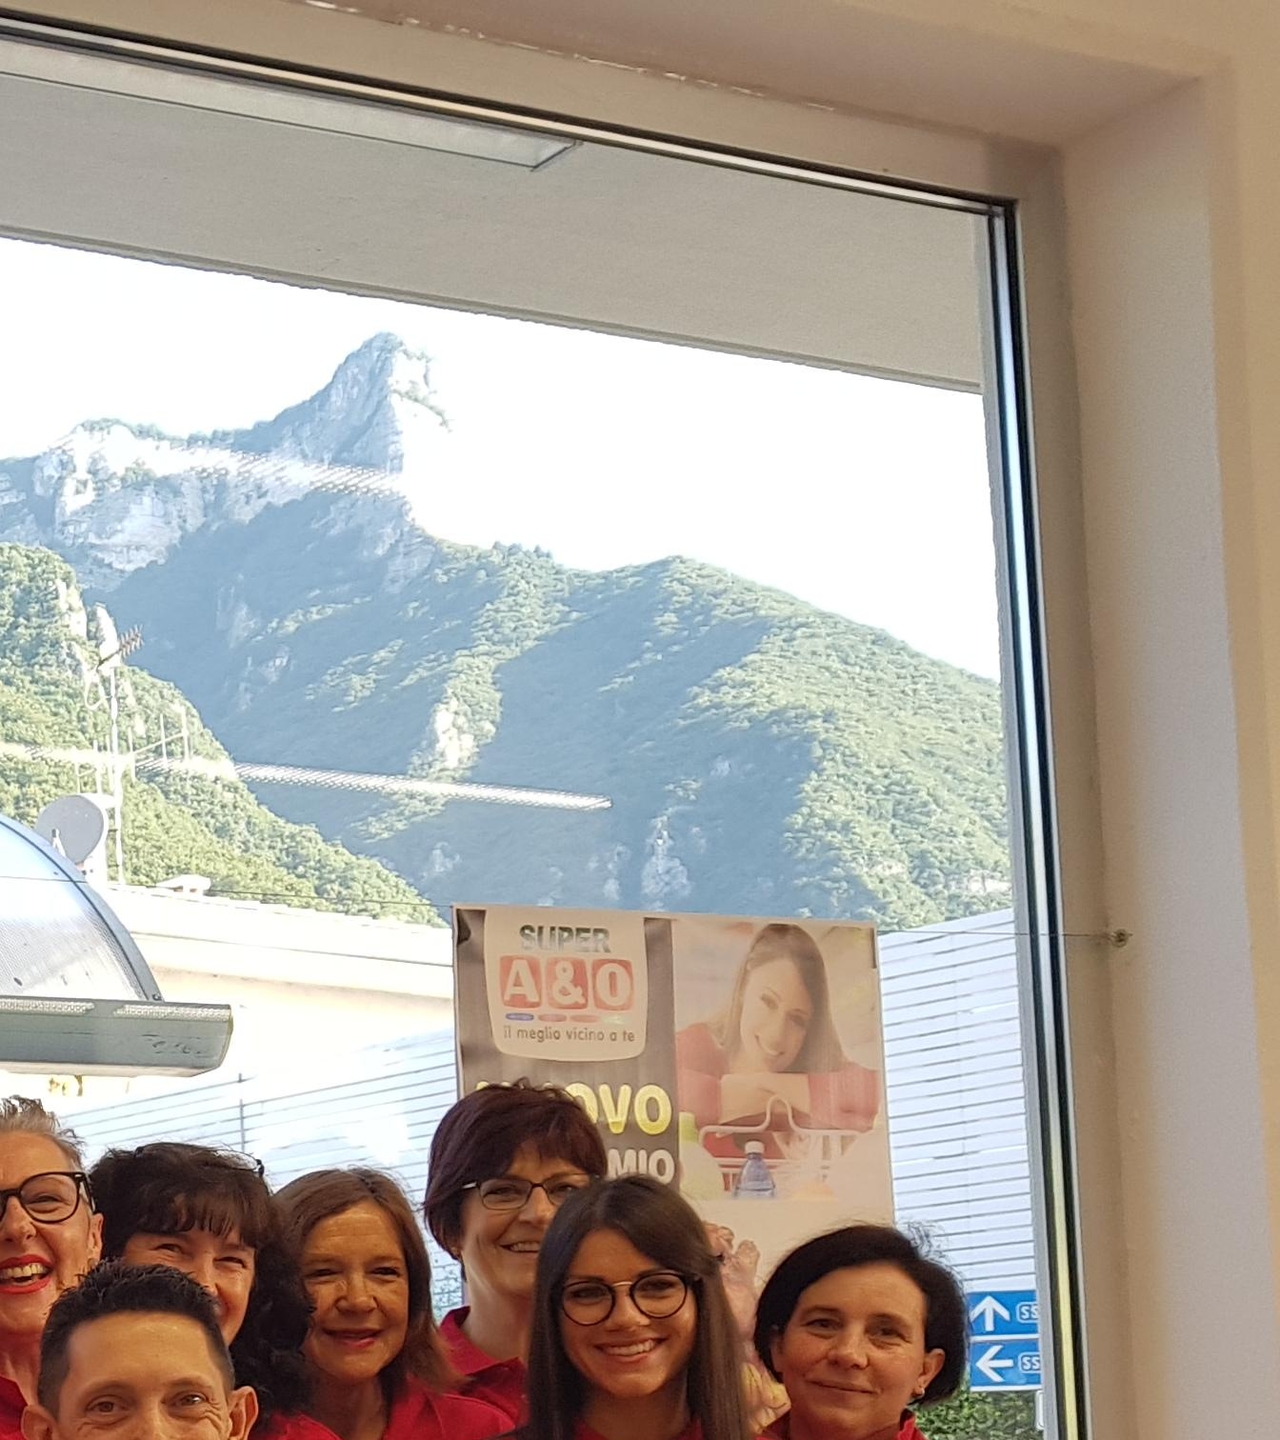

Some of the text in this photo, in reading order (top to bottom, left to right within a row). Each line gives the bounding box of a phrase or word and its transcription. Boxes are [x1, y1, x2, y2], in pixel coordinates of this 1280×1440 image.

[519, 924, 612, 953] SUPER
[503, 959, 632, 1006] A&O
[503, 1024, 636, 1043] il meglio vicino a te
